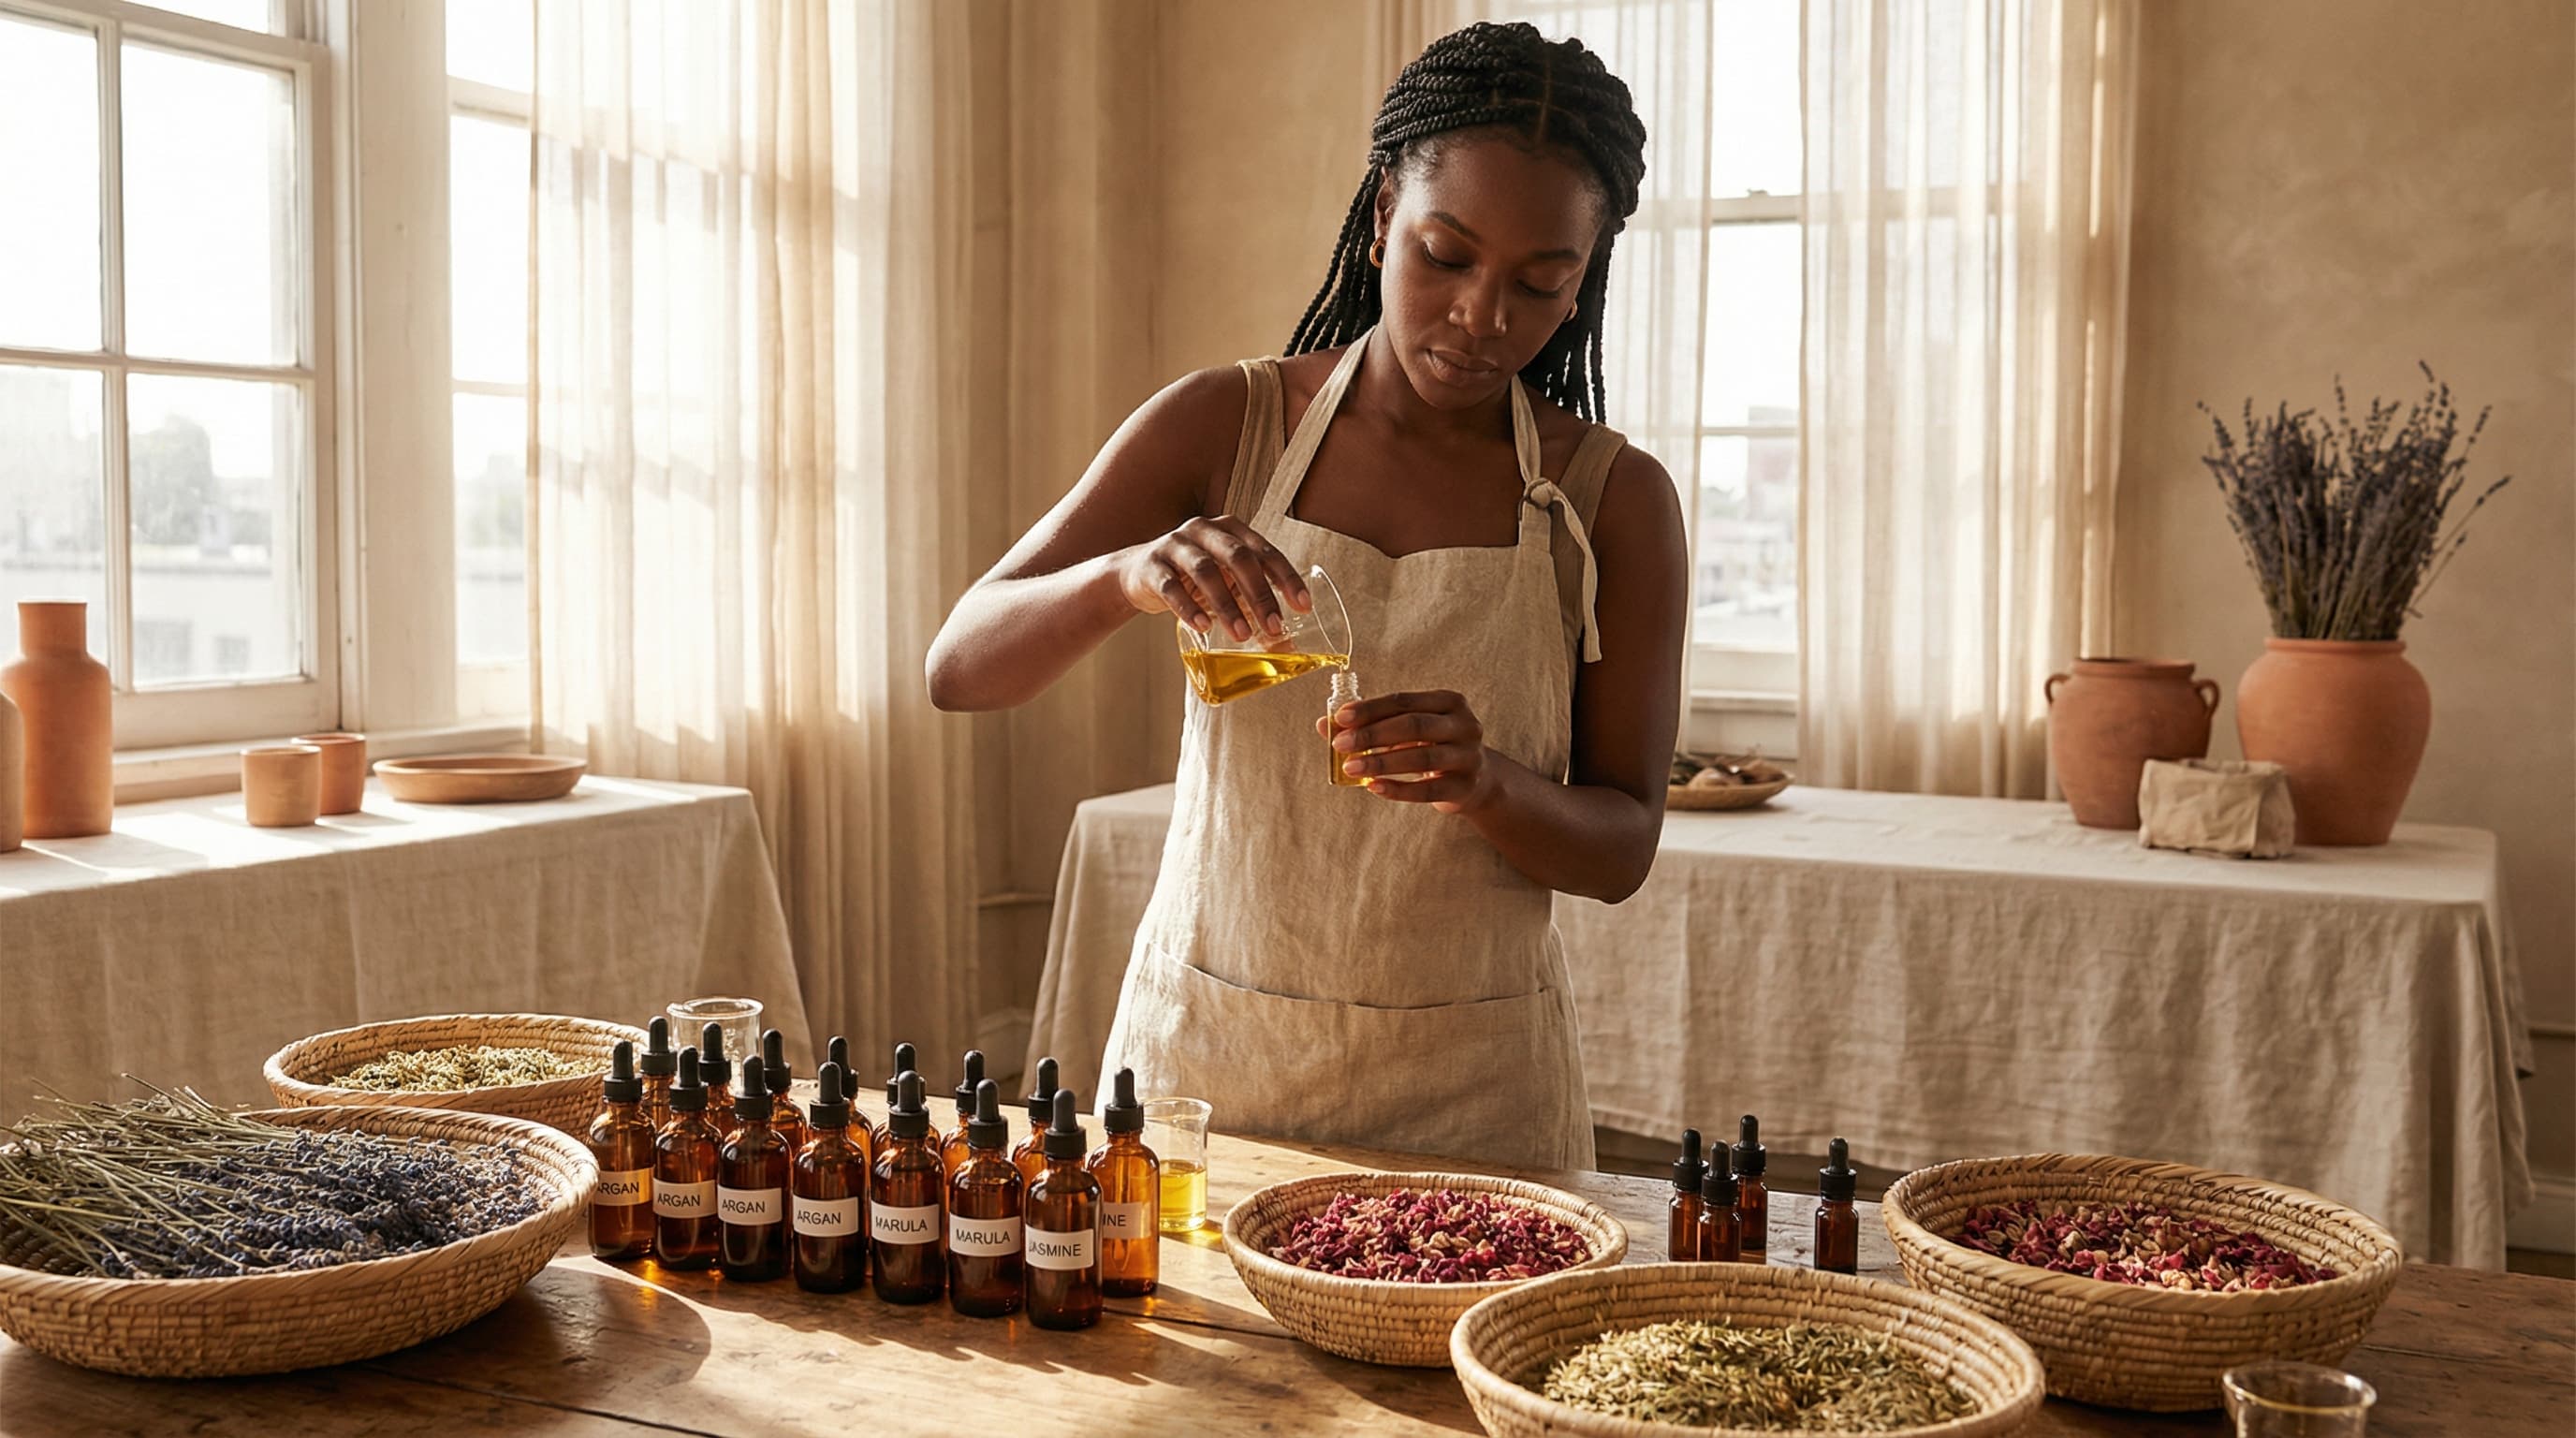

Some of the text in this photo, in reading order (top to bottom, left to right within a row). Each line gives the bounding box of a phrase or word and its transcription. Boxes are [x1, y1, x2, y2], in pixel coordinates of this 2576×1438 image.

[658, 1193, 700, 1207] ARGAN
[722, 1199, 765, 1213] ARGAN
[798, 1210, 841, 1225] ARGAN
[875, 1216, 928, 1232] MARULA
[1103, 1213, 1126, 1226] INE
[956, 1228, 1011, 1244] MARULA
